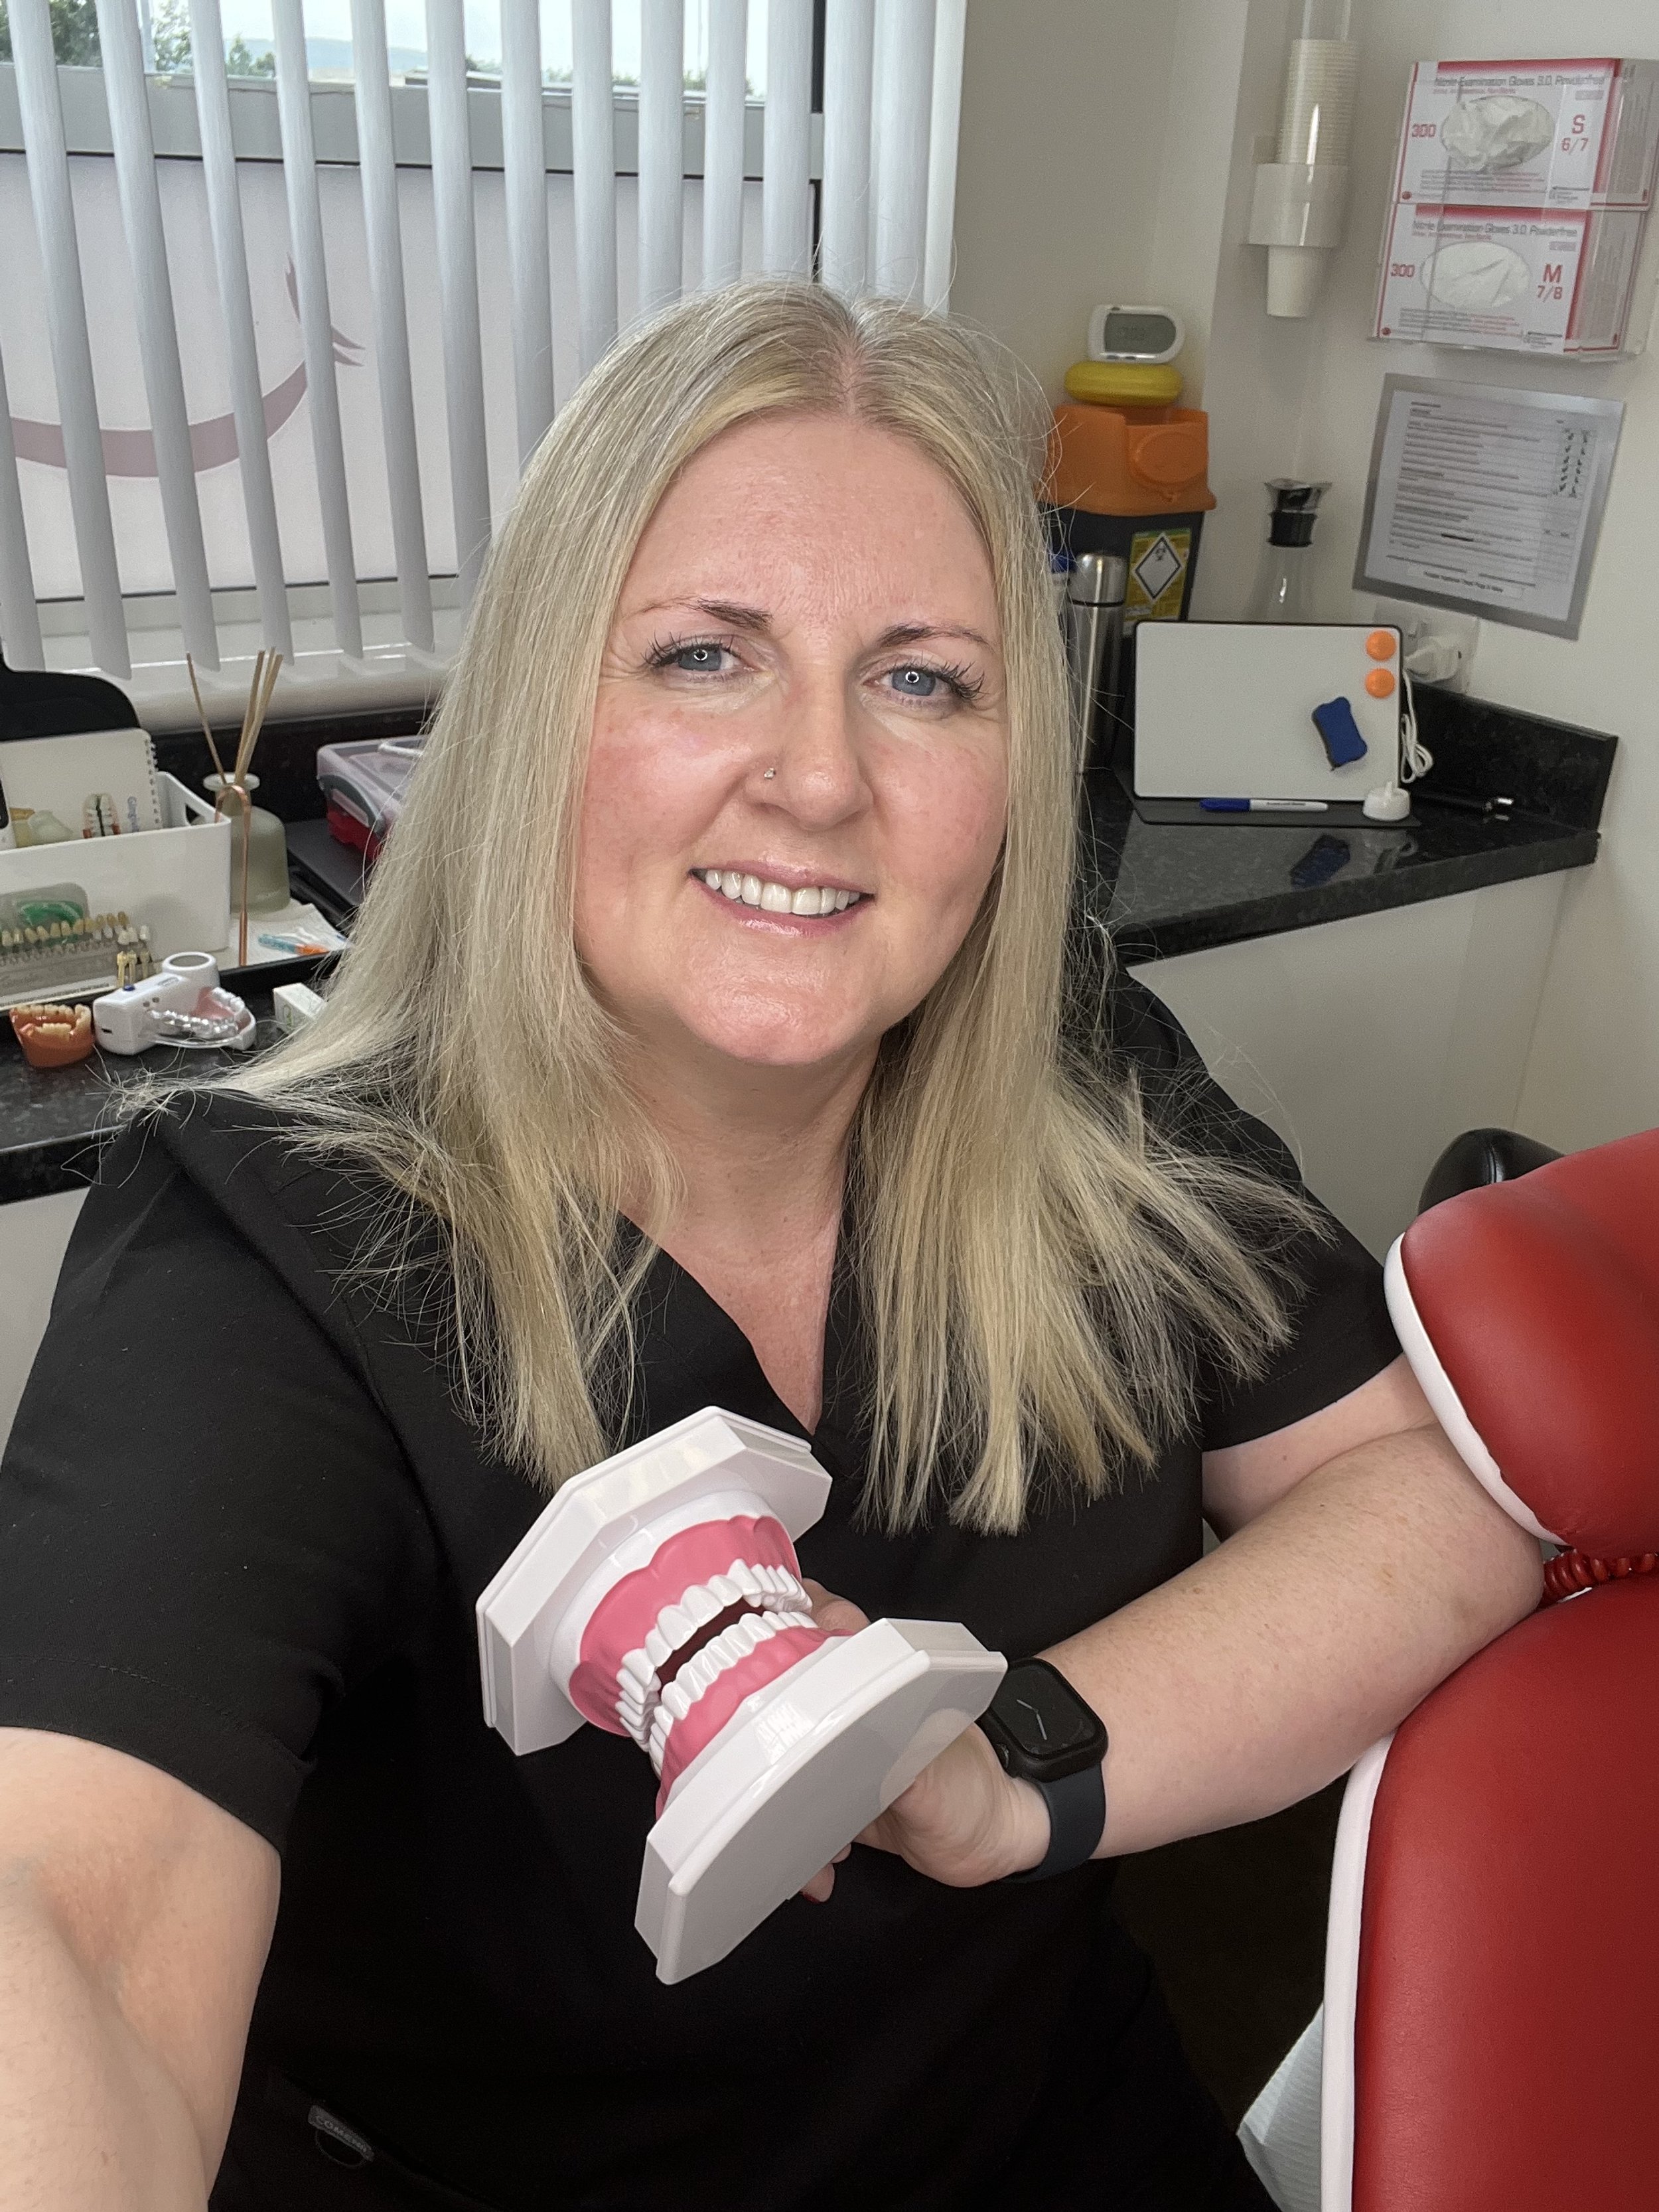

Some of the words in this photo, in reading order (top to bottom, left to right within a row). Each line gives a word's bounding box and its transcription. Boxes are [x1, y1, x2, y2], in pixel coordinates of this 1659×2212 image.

[1411, 123, 1436, 137] 300
[1572, 114, 1585, 133] S
[1561, 137, 1589, 155] 6/7
[1390, 263, 1415, 277] 300
[1543, 263, 1563, 283] M
[1538, 285, 1563, 303] 7/8
